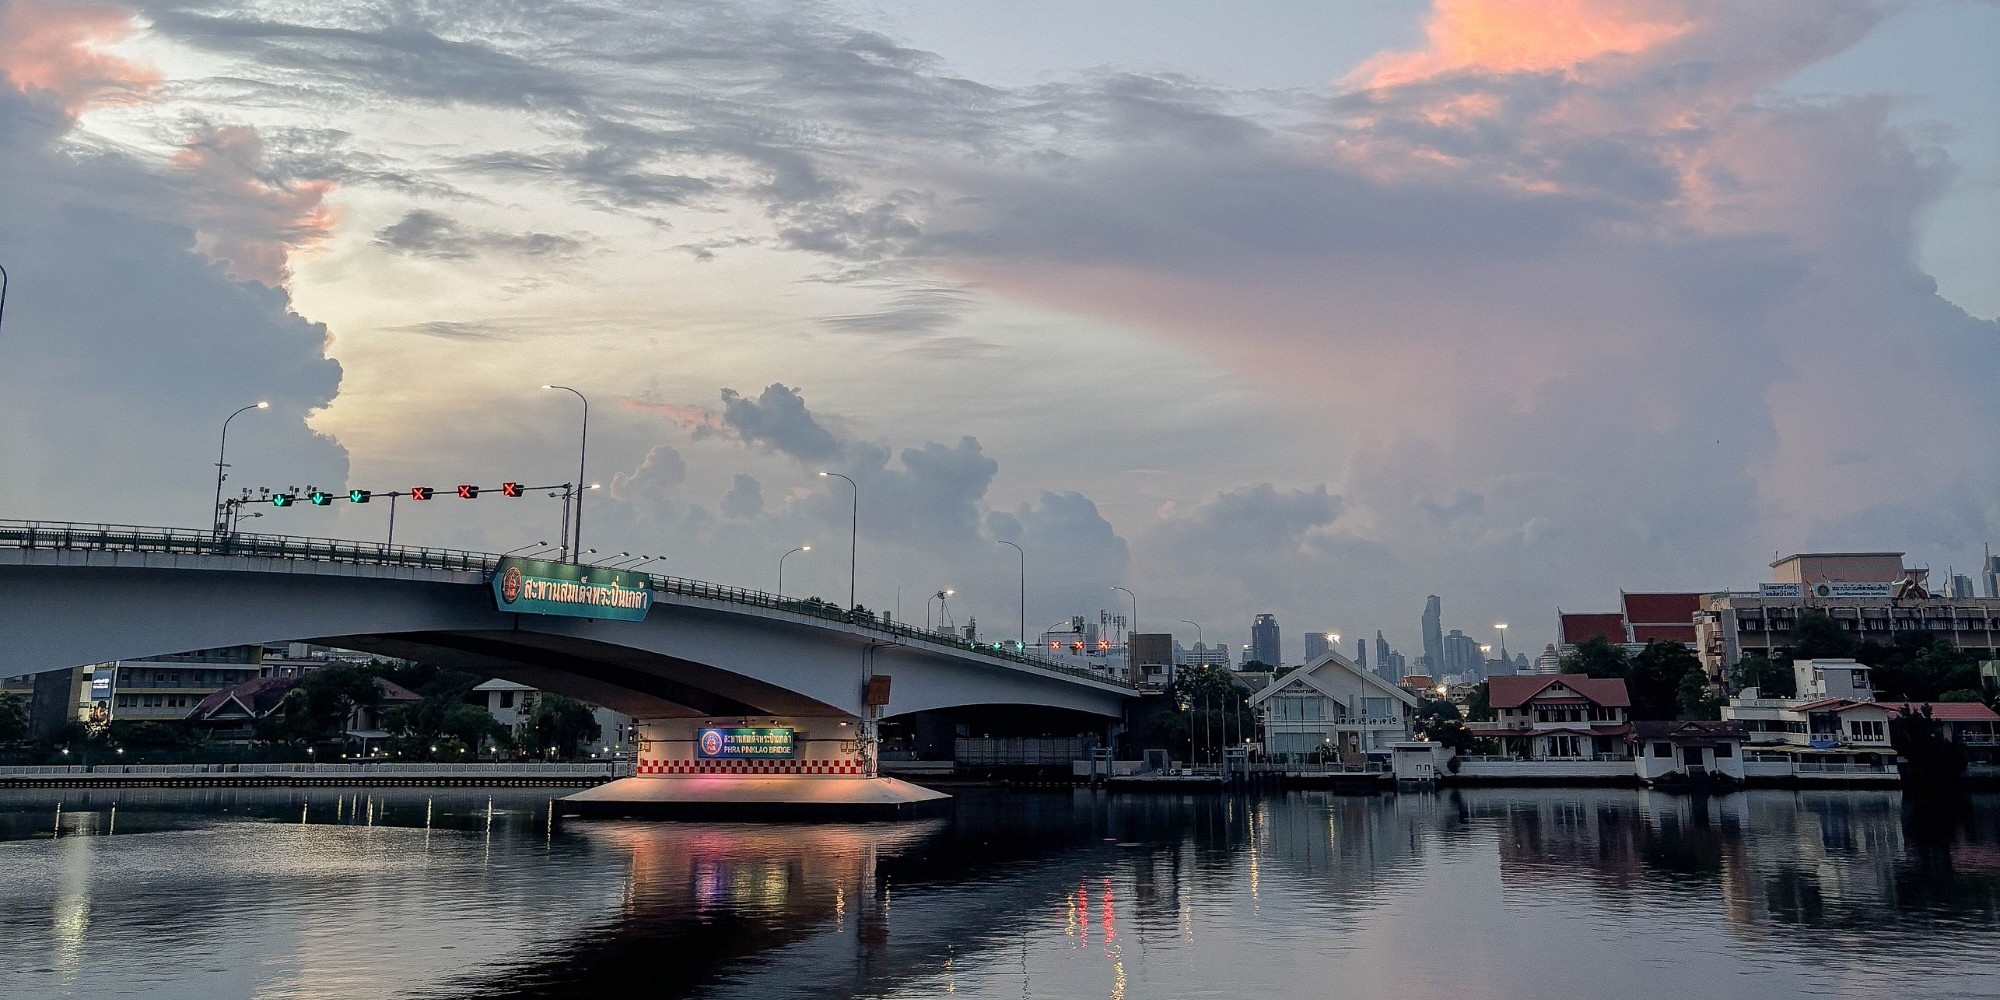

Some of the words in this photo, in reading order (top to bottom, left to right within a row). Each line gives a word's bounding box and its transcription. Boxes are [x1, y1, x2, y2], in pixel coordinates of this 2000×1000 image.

[524, 575, 648, 610] สะพานสมเด็จพระปิ่นเกล้า
[723, 746, 741, 754] PHRA
[741, 746, 768, 754] PINKLAO
[769, 746, 791, 754] BRIDGE
